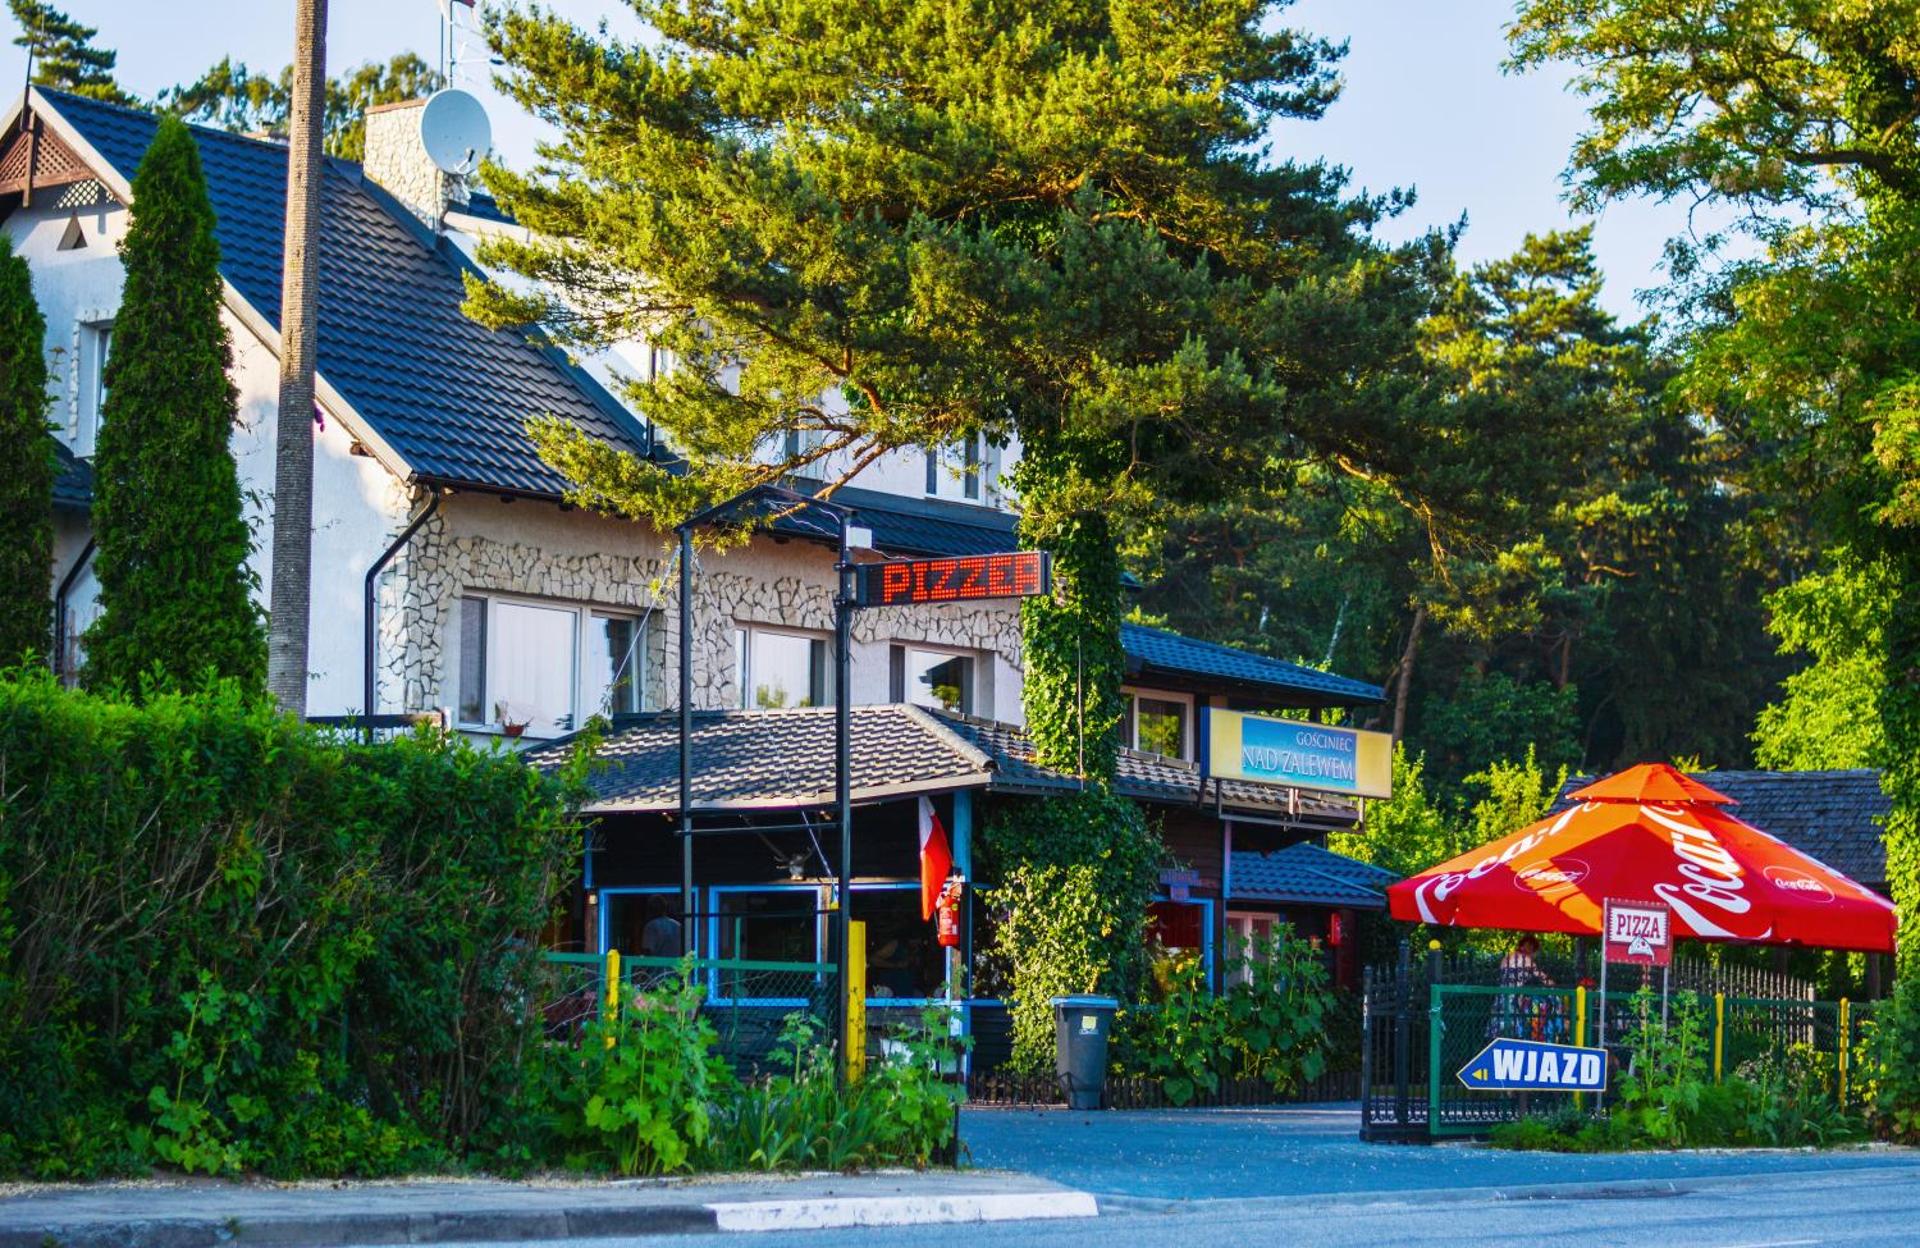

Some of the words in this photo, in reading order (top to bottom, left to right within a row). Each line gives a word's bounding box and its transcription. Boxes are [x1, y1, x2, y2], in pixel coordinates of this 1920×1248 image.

[1242, 746, 1279, 772] NAD
[1281, 751, 1354, 781] ZALEWEM
[1616, 913, 1661, 939] PIZZA
[1492, 1048, 1601, 1086] WJAZD
